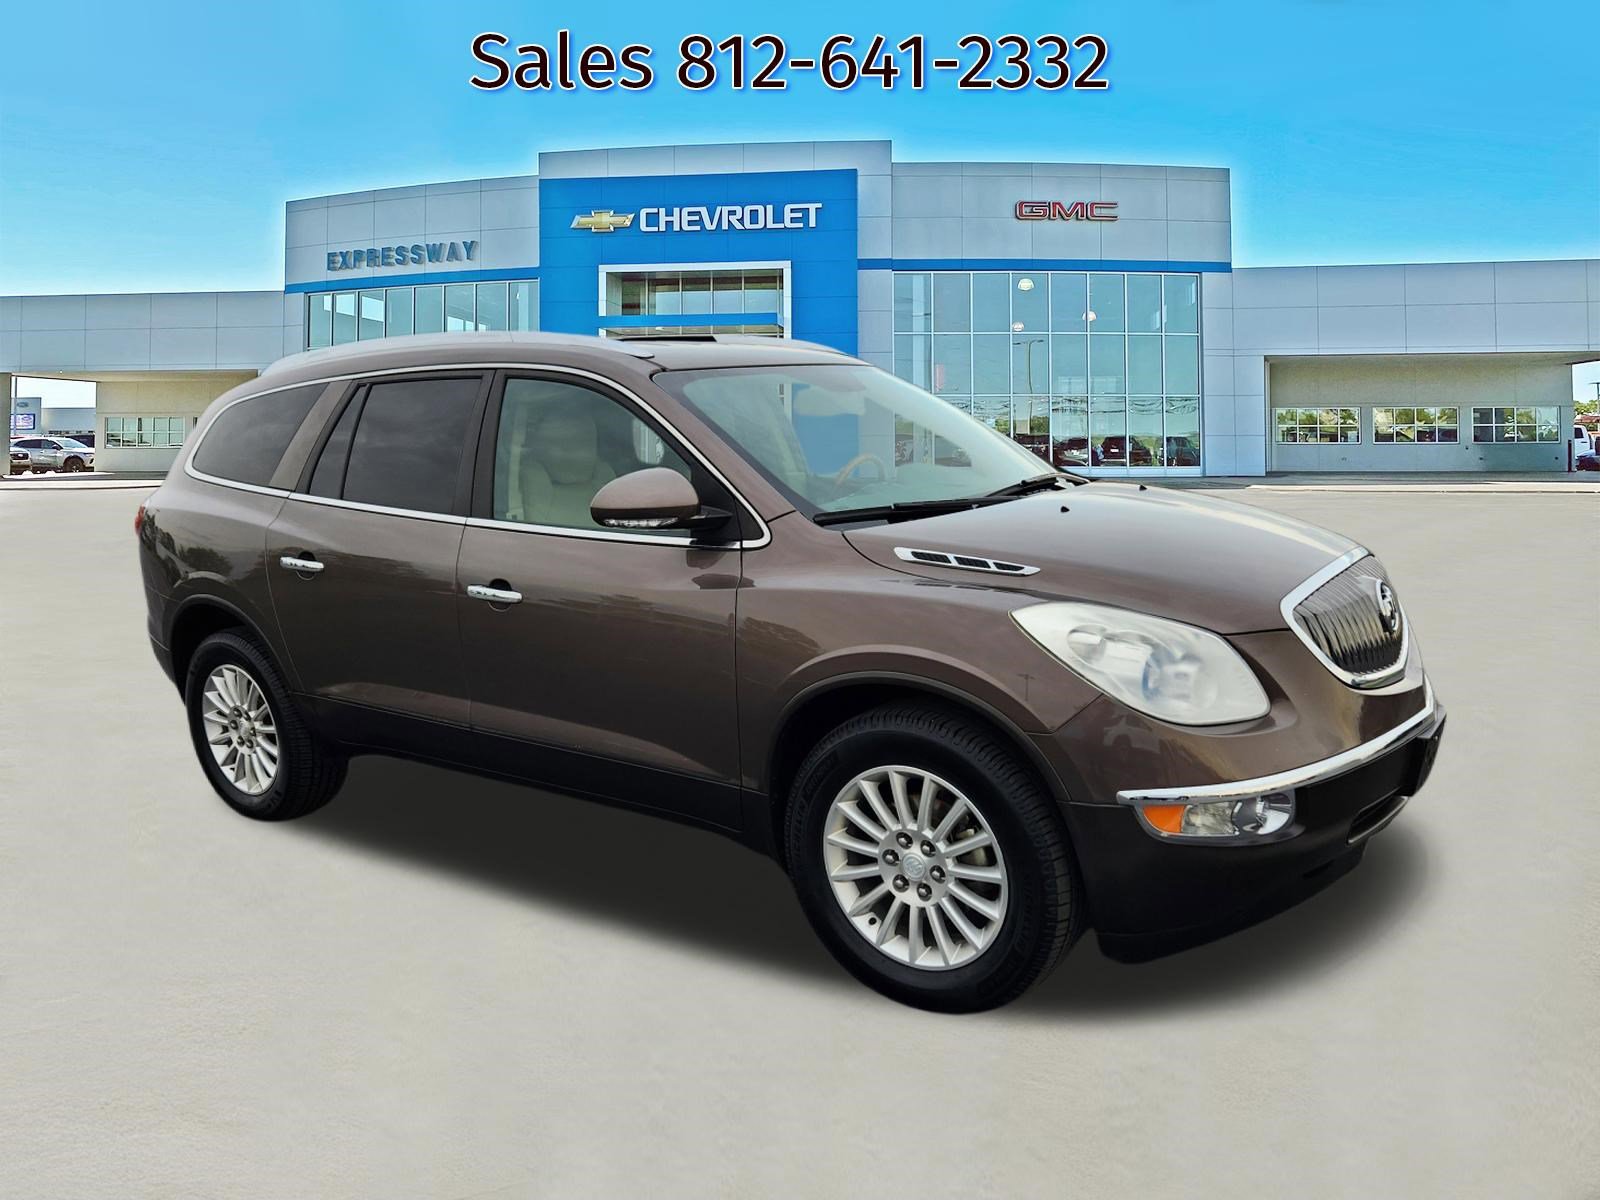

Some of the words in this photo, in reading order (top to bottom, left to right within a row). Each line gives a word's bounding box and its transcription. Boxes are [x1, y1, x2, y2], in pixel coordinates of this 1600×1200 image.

[640, 203, 822, 232] CHEVROLET
[1015, 200, 1118, 220] GMC
[327, 241, 479, 271] EXPRESSWAY
